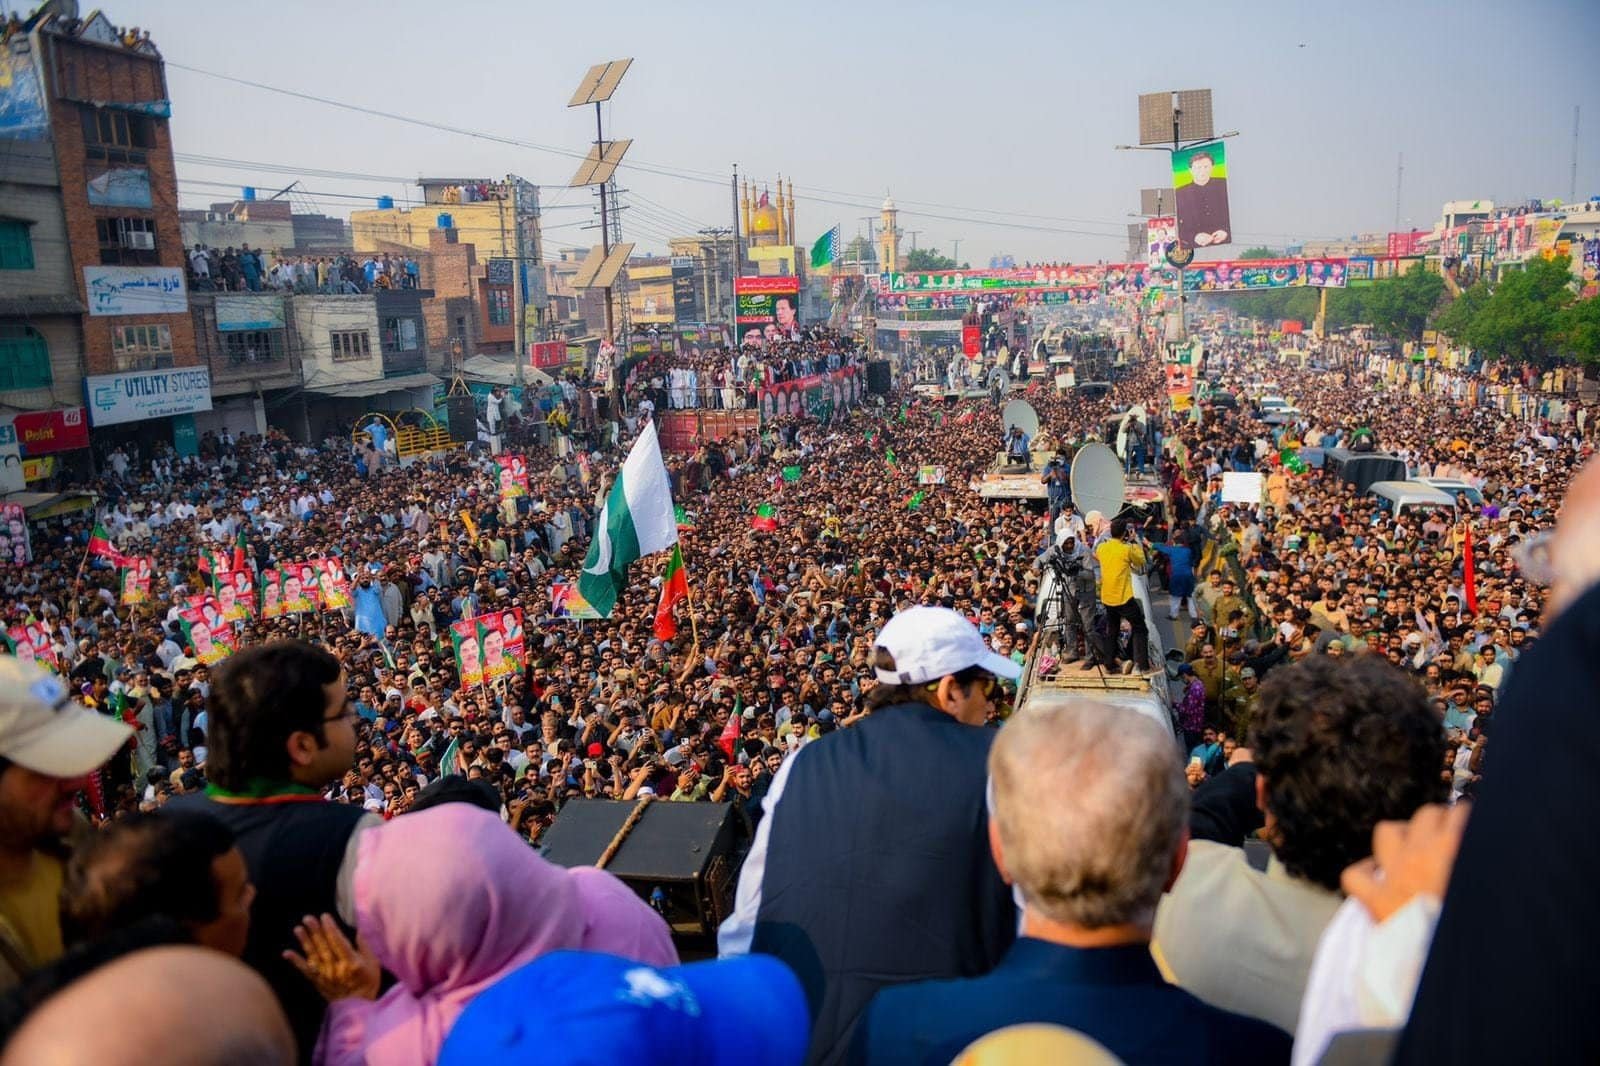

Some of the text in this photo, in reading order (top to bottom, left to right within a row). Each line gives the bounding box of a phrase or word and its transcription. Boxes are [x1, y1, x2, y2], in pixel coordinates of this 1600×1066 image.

[125, 371, 208, 397] UTILITY STORES
[25, 427, 55, 442] Point
